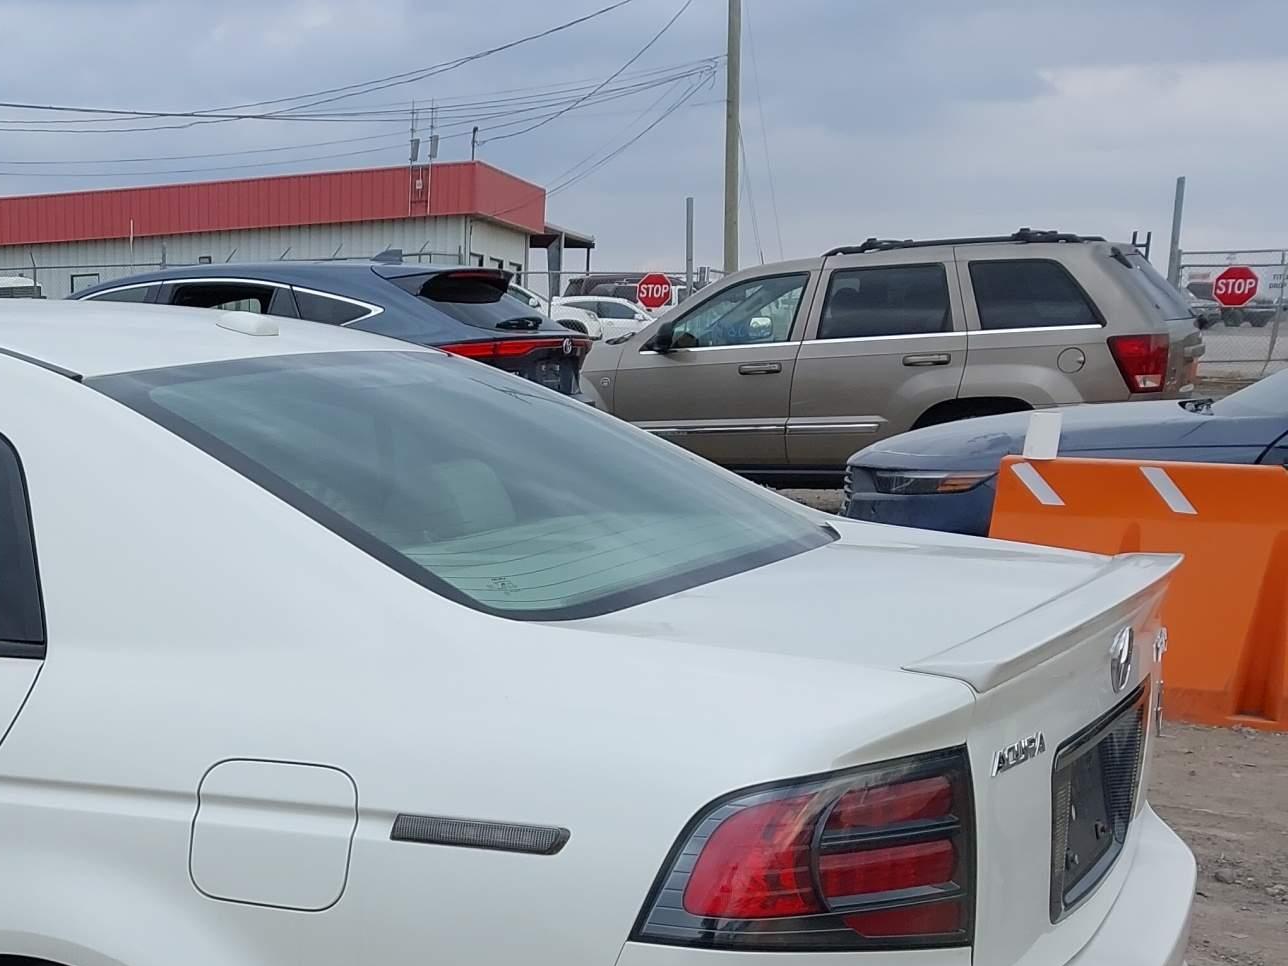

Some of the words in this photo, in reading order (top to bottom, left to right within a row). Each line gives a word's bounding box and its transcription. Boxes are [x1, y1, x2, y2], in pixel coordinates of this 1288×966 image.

[639, 284, 670, 298] STOP
[1215, 278, 1256, 295] STOP
[991, 730, 1046, 777] ACURA
